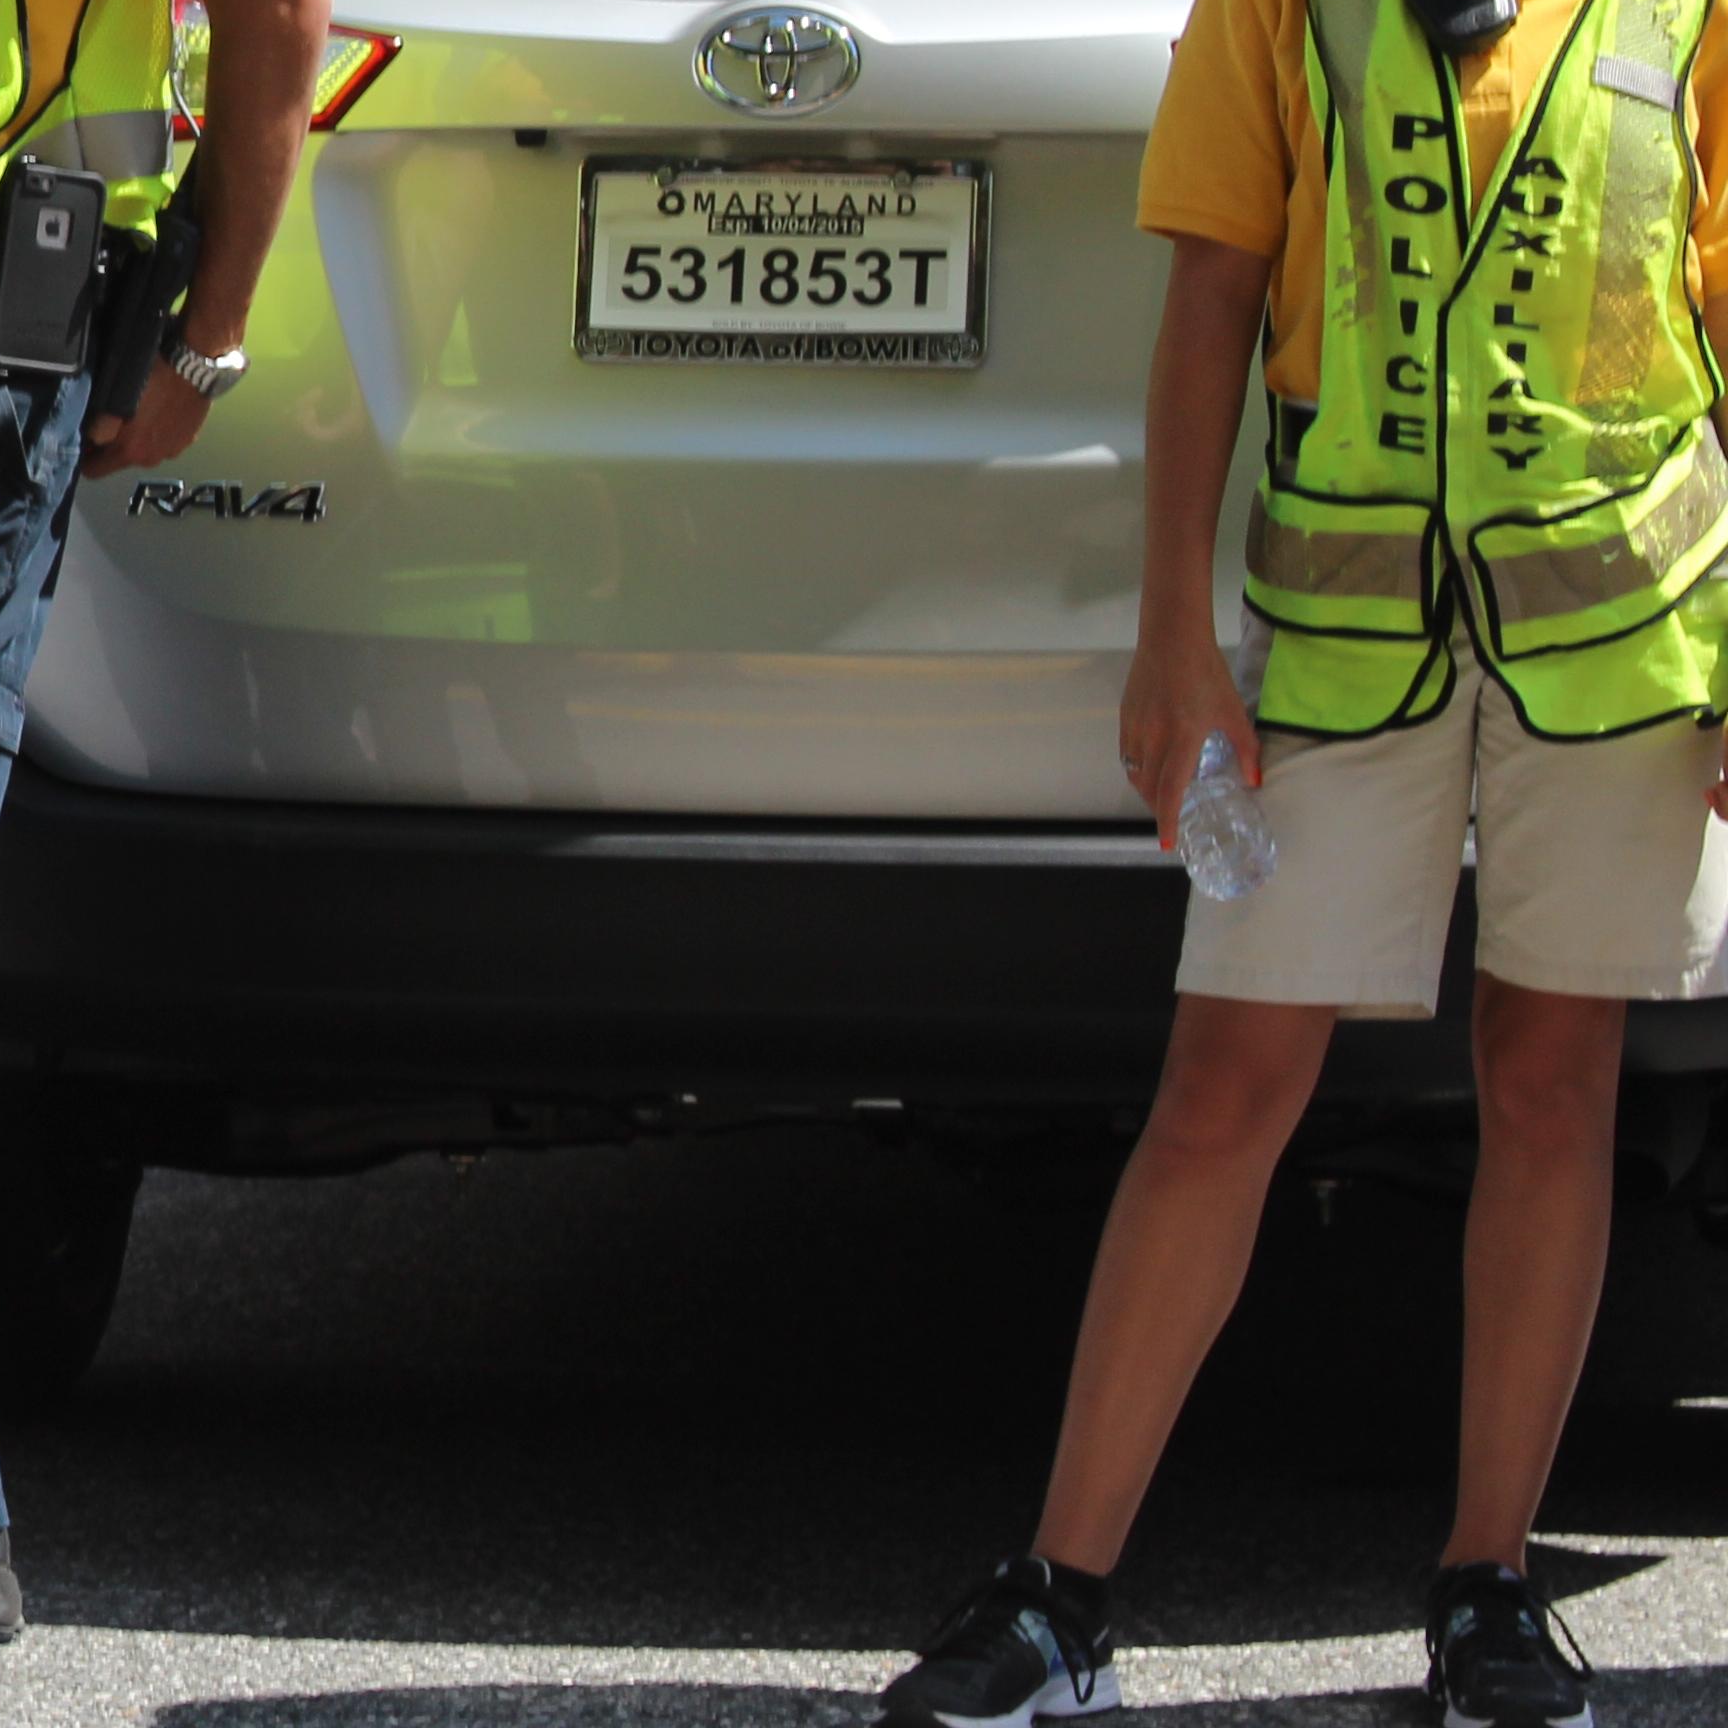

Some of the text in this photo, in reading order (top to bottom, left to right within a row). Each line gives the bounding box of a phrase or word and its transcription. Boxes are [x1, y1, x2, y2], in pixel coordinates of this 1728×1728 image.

[694, 190, 917, 216] MARYLAND
[621, 245, 947, 306] 531853T
[1379, 114, 1447, 455] POLICE
[1487, 156, 1568, 469] AUXILIARY
[630, 336, 927, 361] TOYOTA of BOWIE
[128, 480, 326, 521] RAV4
